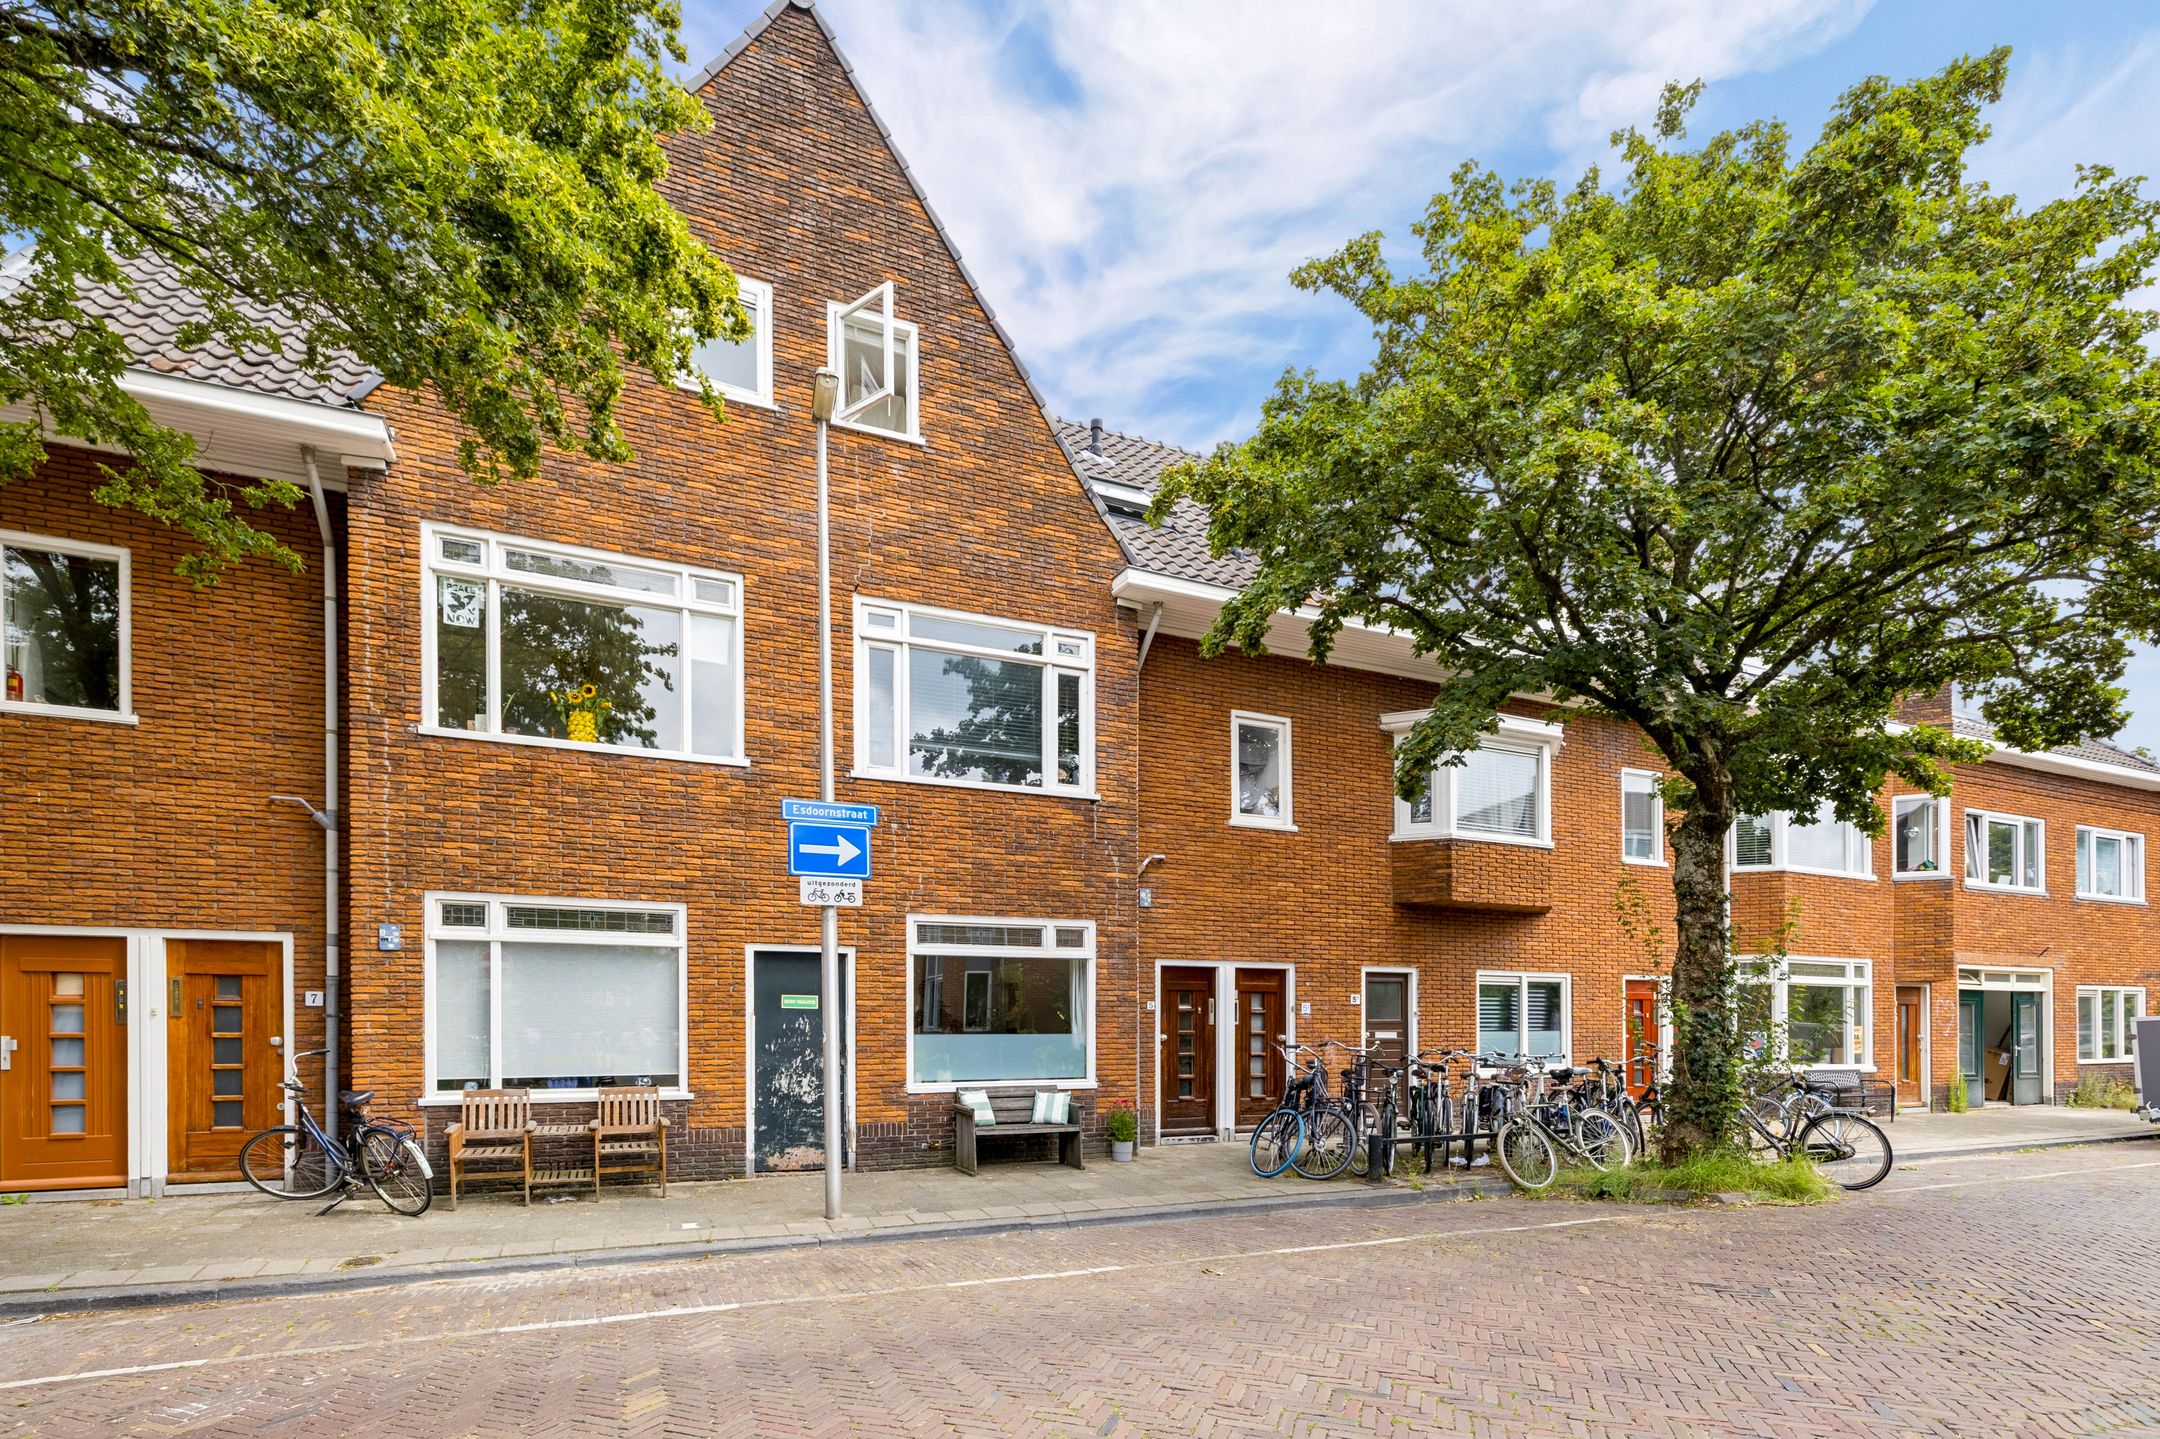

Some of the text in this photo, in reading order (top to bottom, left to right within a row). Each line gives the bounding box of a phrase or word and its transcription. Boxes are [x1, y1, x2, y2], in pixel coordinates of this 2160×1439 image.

[447, 582, 476, 594] PEACE
[446, 613, 476, 625] NOW
[792, 804, 868, 819] Esdoornstraat
[807, 880, 856, 888] uitgezonderd
[310, 993, 318, 1004] 7
